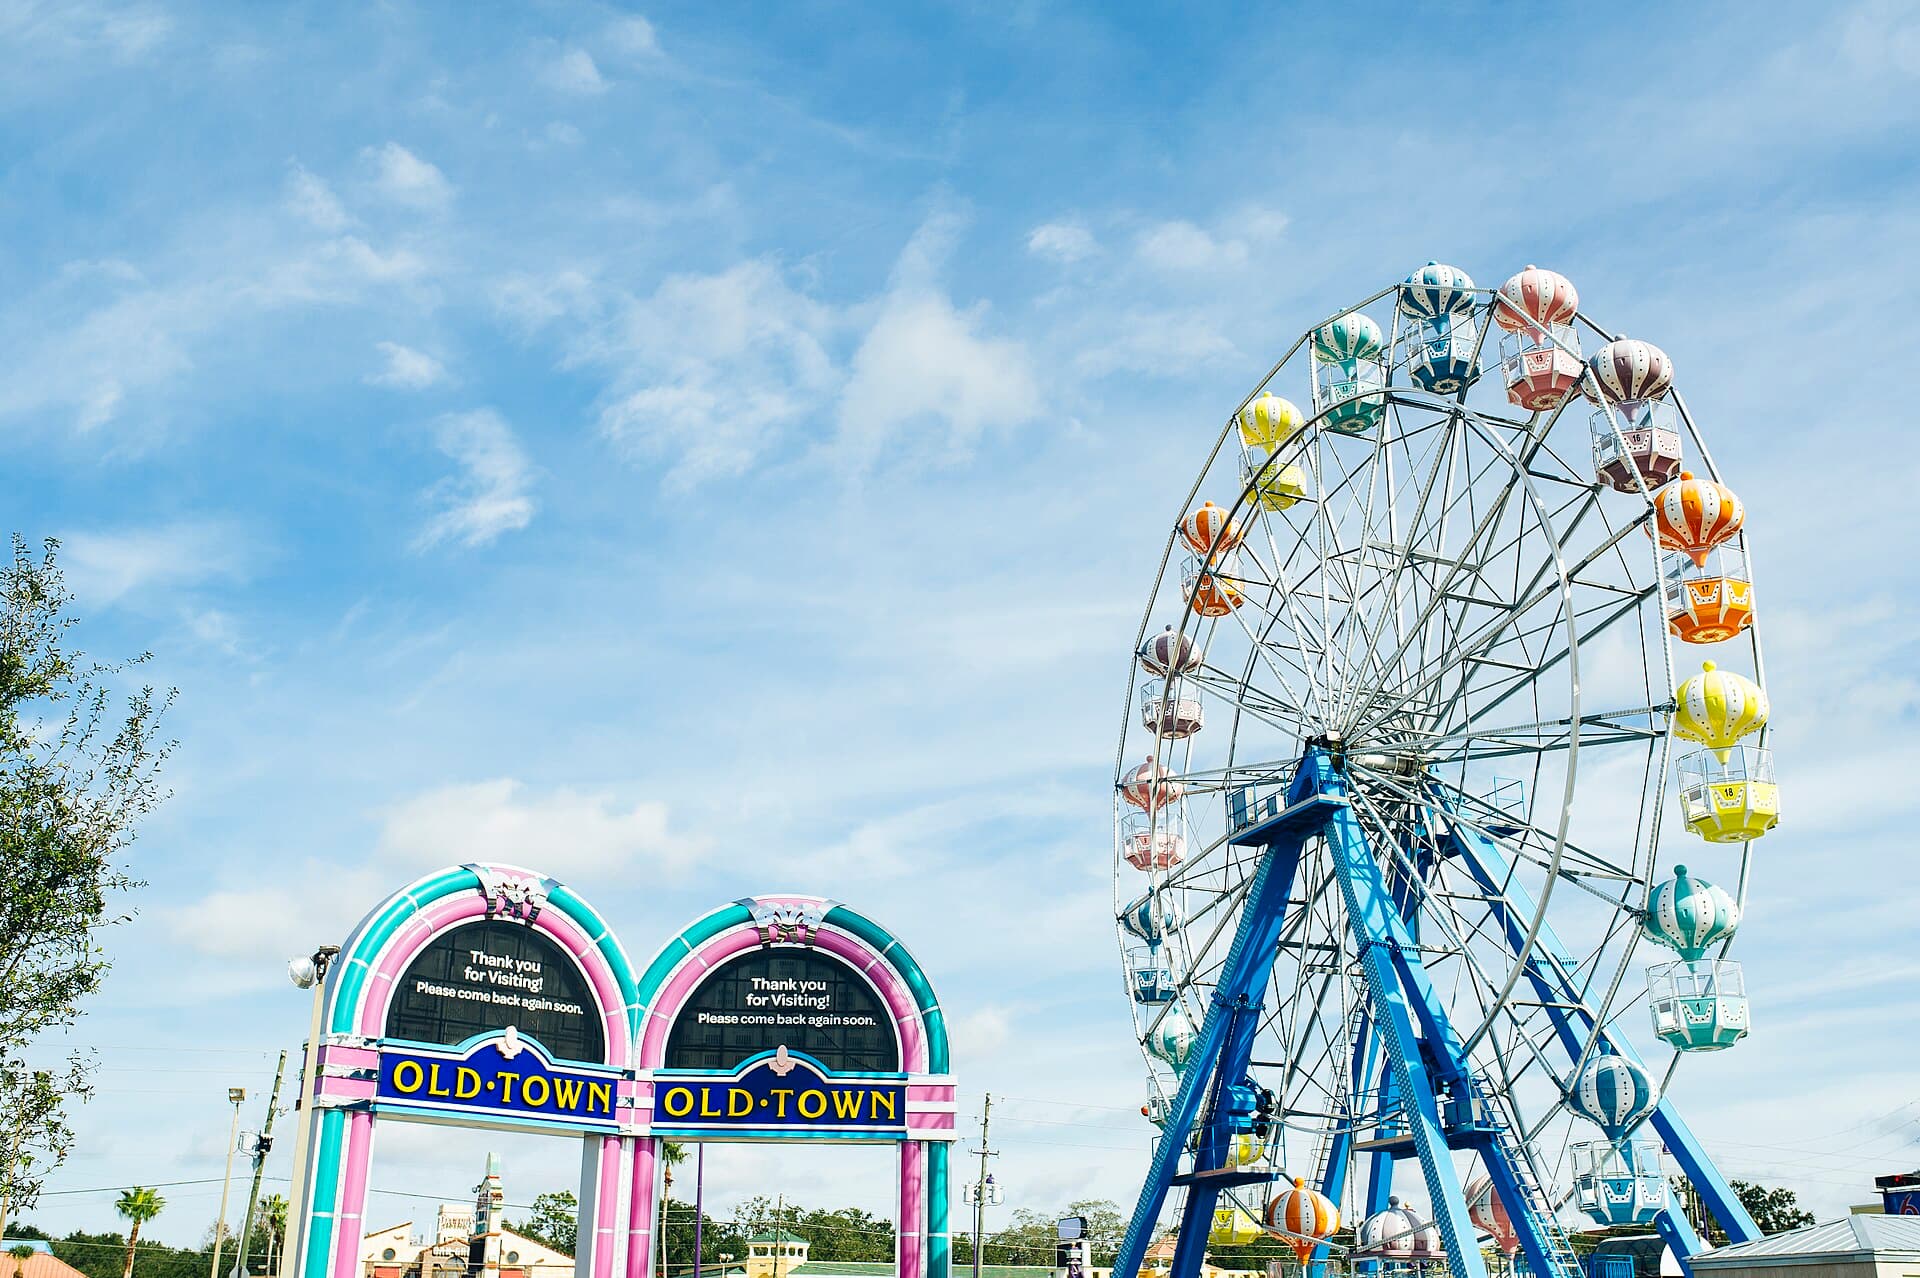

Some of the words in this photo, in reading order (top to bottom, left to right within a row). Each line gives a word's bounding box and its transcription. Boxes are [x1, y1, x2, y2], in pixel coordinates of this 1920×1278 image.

[1535, 354, 1543, 362] 15
[1632, 433, 1641, 442] 16
[1701, 584, 1710, 593] 17
[1724, 787, 1734, 797] 18
[470, 950, 515, 970] Thank
[515, 959, 541, 974] you
[464, 966, 486, 982] for
[487, 970, 543, 993] Visiting!
[750, 977, 798, 991] Thank
[799, 980, 827, 994] you
[416, 981, 456, 998] Please
[457, 988, 491, 1002] come
[492, 991, 521, 1006] back
[521, 996, 553, 1011] again
[553, 1001, 583, 1015] soon.
[745, 993, 769, 1007] for
[770, 994, 830, 1010] Visiting!
[1695, 1002, 1701, 1012] 1
[698, 1013, 739, 1024] Please
[740, 1015, 775, 1025] come
[776, 1013, 806, 1025] back
[807, 1014, 841, 1028] again
[842, 1016, 876, 1026] soon.
[1616, 1182, 1622, 1192] 2
[1899, 1193, 1920, 1215] 6
